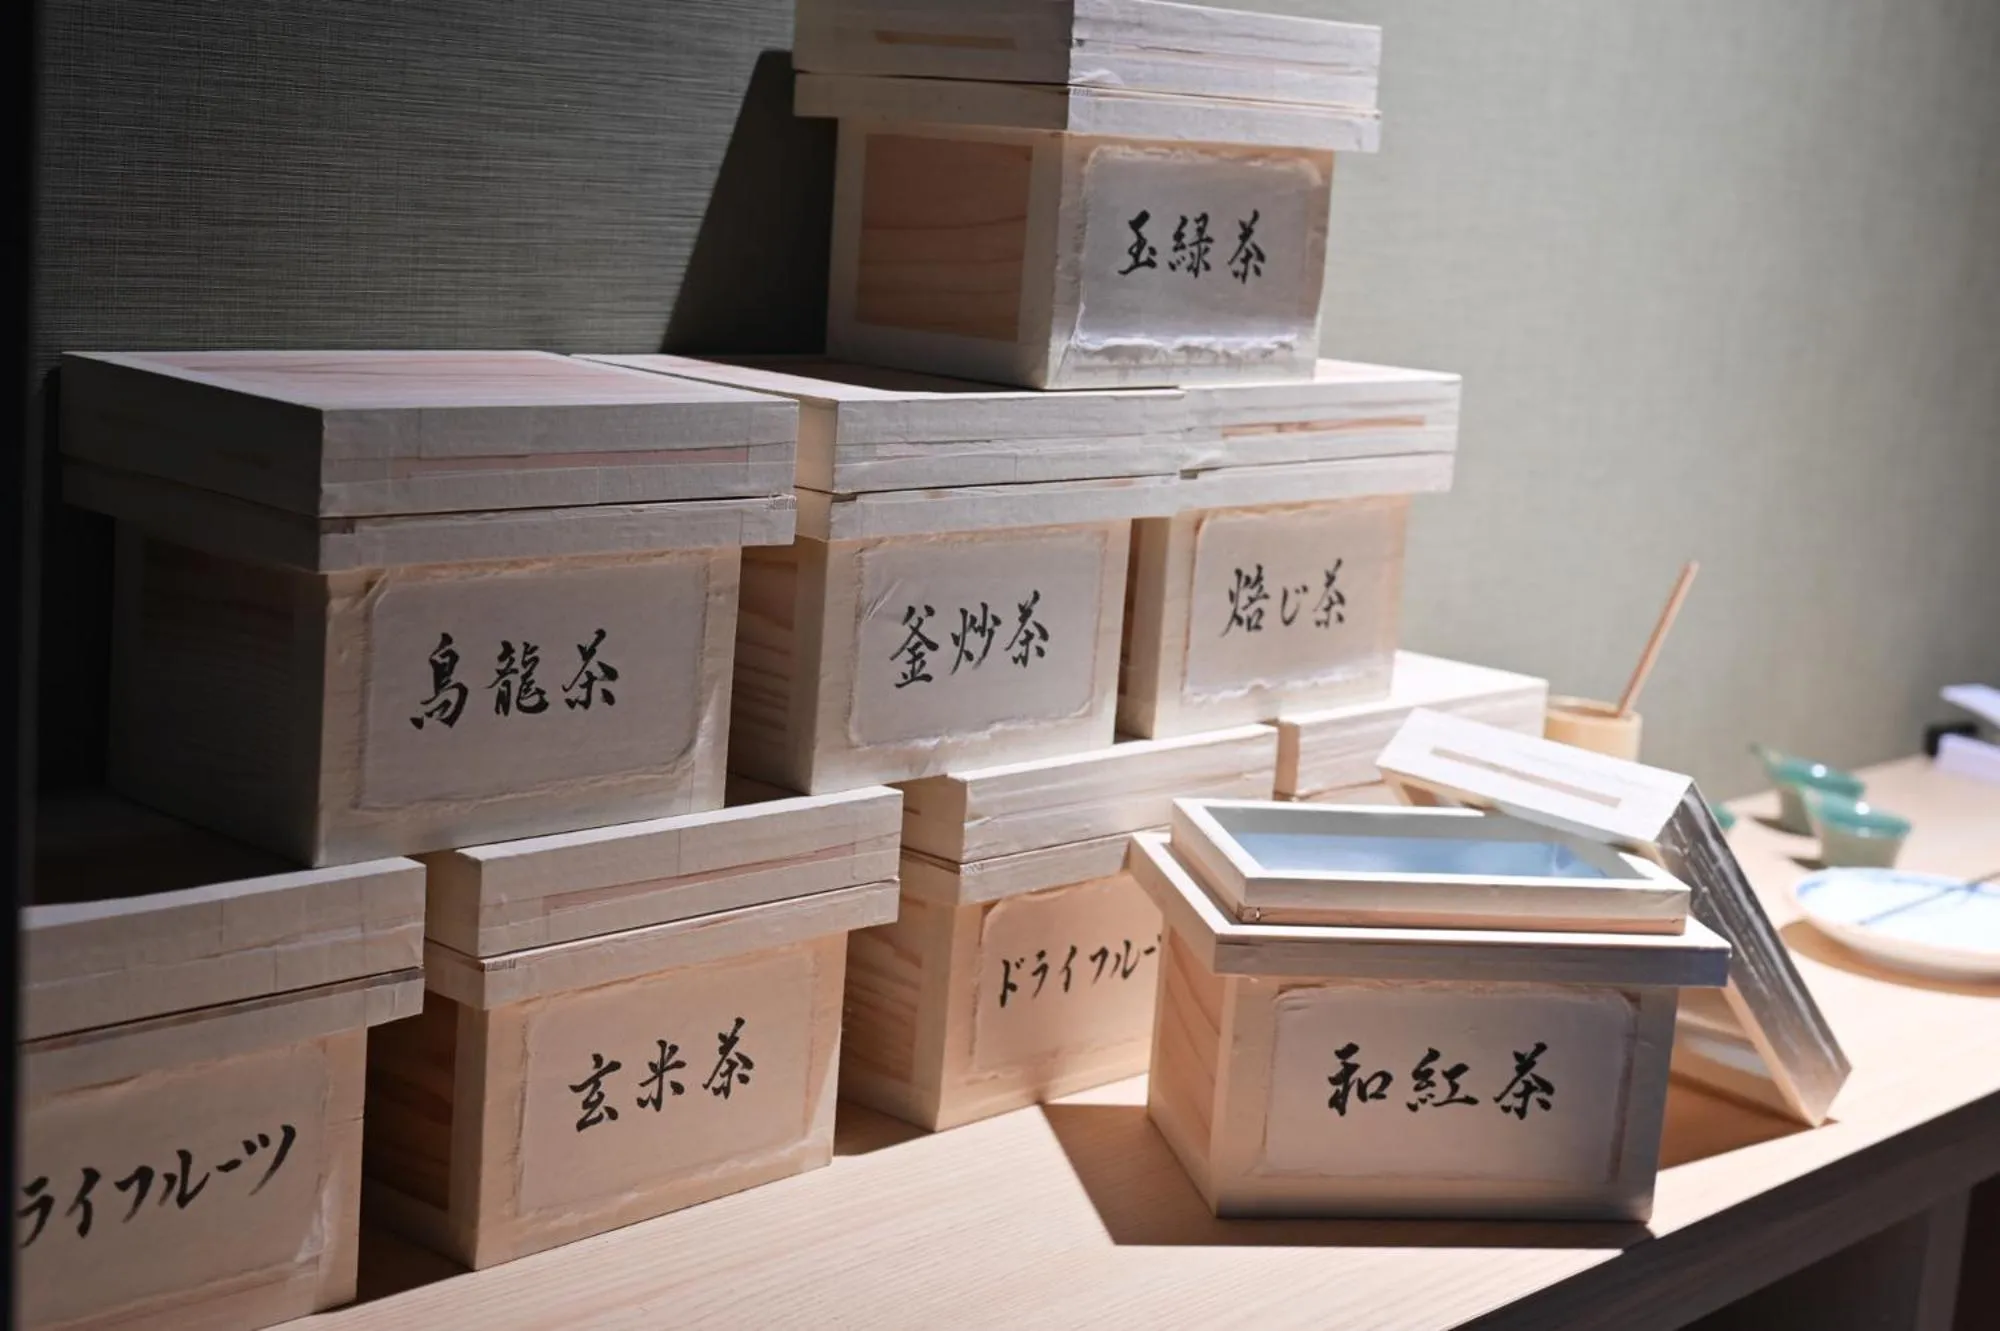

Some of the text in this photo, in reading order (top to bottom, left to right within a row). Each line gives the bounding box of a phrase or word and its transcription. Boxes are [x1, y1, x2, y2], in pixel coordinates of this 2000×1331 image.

[1118, 209, 1266, 285] 玉緑茶
[1220, 558, 1346, 638] 焙じ茶
[889, 589, 1050, 689] 釜炒茶
[999, 933, 1162, 1008] ドライフルー
[568, 1016, 754, 1133] 玄米茶
[1327, 1041, 1555, 1121] 和紅茶
